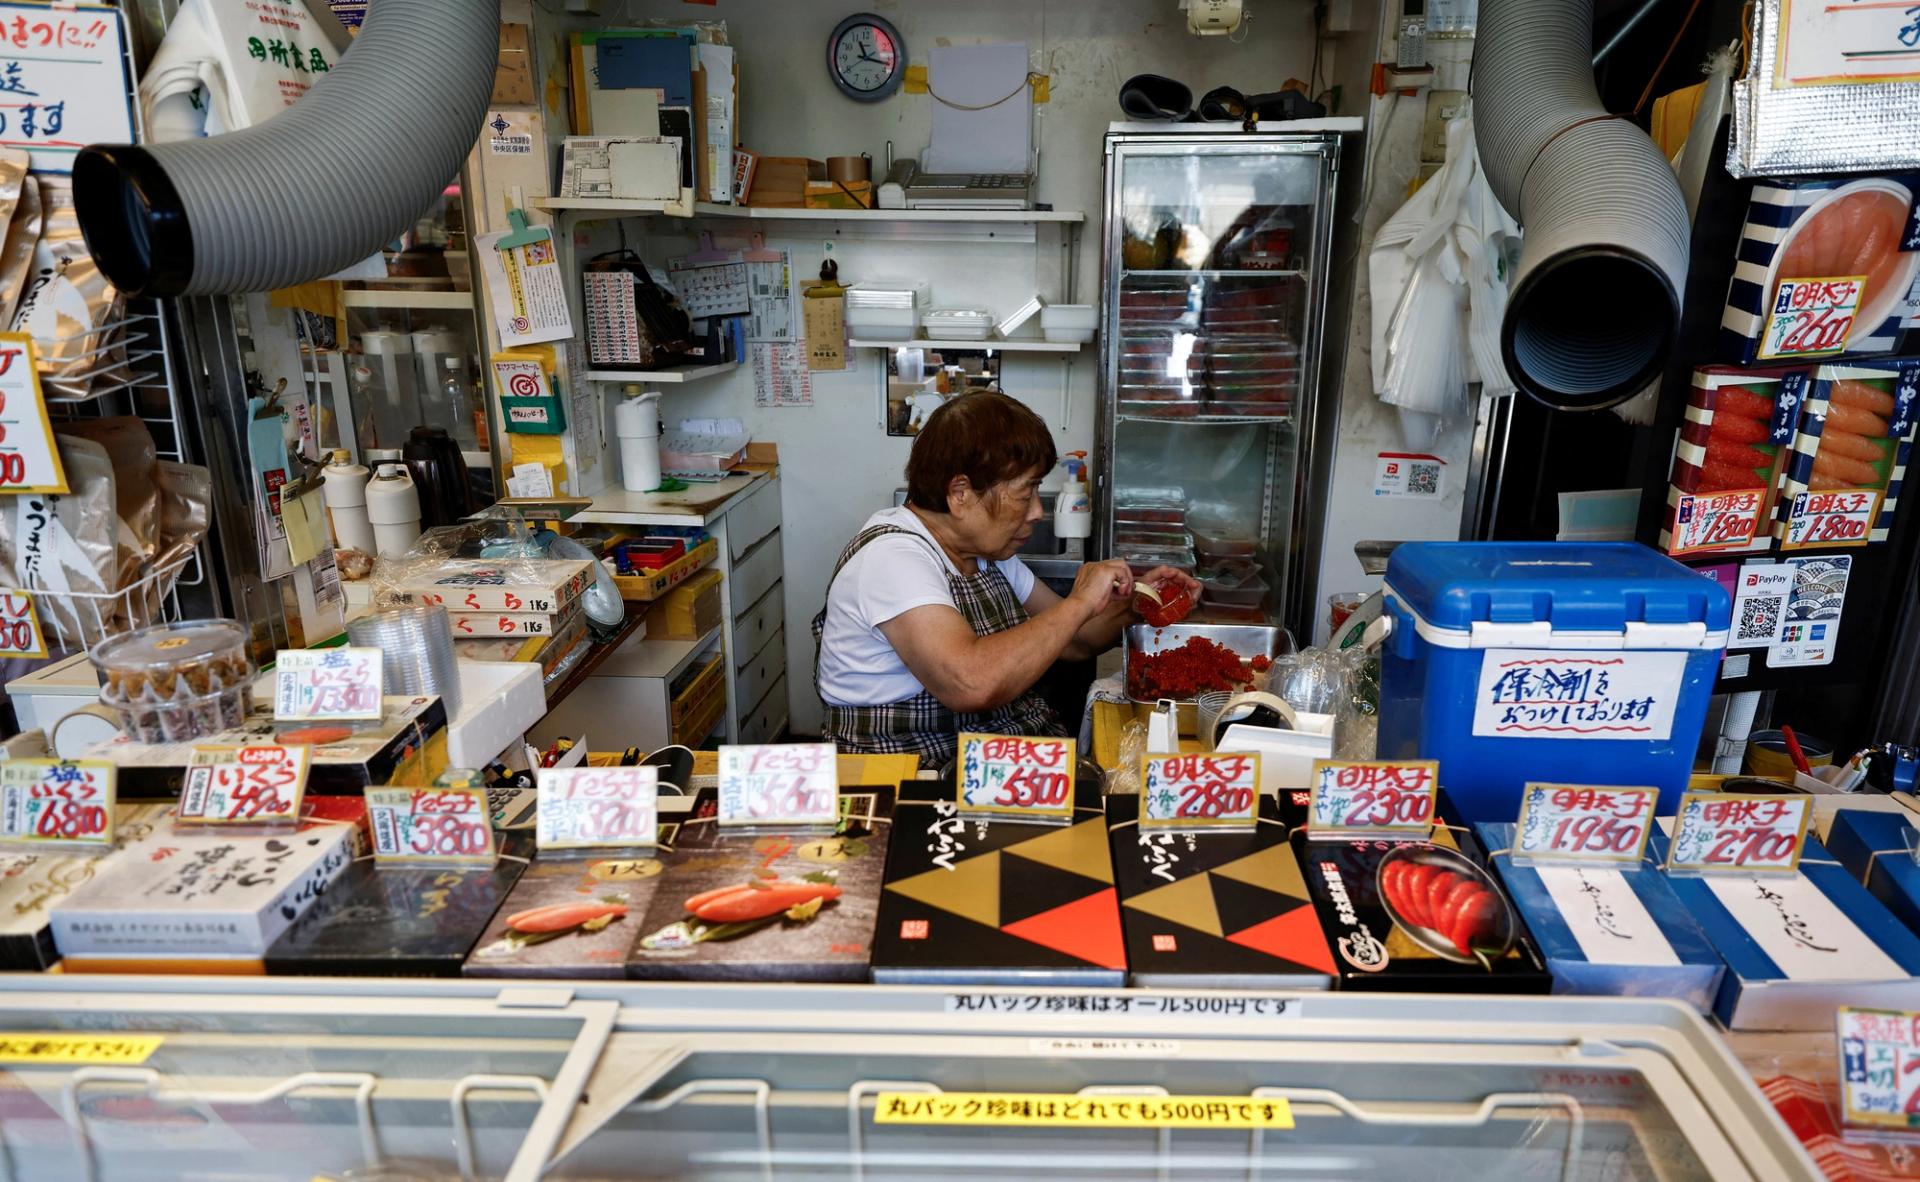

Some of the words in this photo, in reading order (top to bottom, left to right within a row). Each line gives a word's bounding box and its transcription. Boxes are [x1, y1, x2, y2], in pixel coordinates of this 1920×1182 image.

[1792, 281, 1857, 309] 明太子
[1711, 493, 1758, 512] 明太子
[1806, 493, 1868, 514] 明太子
[1759, 575, 1788, 584] PayPay
[1796, 583, 1828, 593] WELCOME
[1491, 667, 1610, 705] 保冷剤を
[1500, 697, 1656, 724] おつけしております
[982, 737, 1068, 768] 明太子
[218, 758, 296, 786] いくら
[1163, 753, 1251, 785] 明太子
[1336, 765, 1433, 792] 明太子
[30, 771, 97, 801] いくら
[1176, 780, 1254, 819] 2.800
[1344, 787, 1434, 826] 2.300
[1551, 787, 1651, 818] 明太子
[1703, 799, 1792, 828] 明太子
[1550, 816, 1642, 852] 1.950
[1701, 827, 1799, 866] 2.700
[887, 1098, 1280, 1121] 丸パック珍味はどれでも500円です
